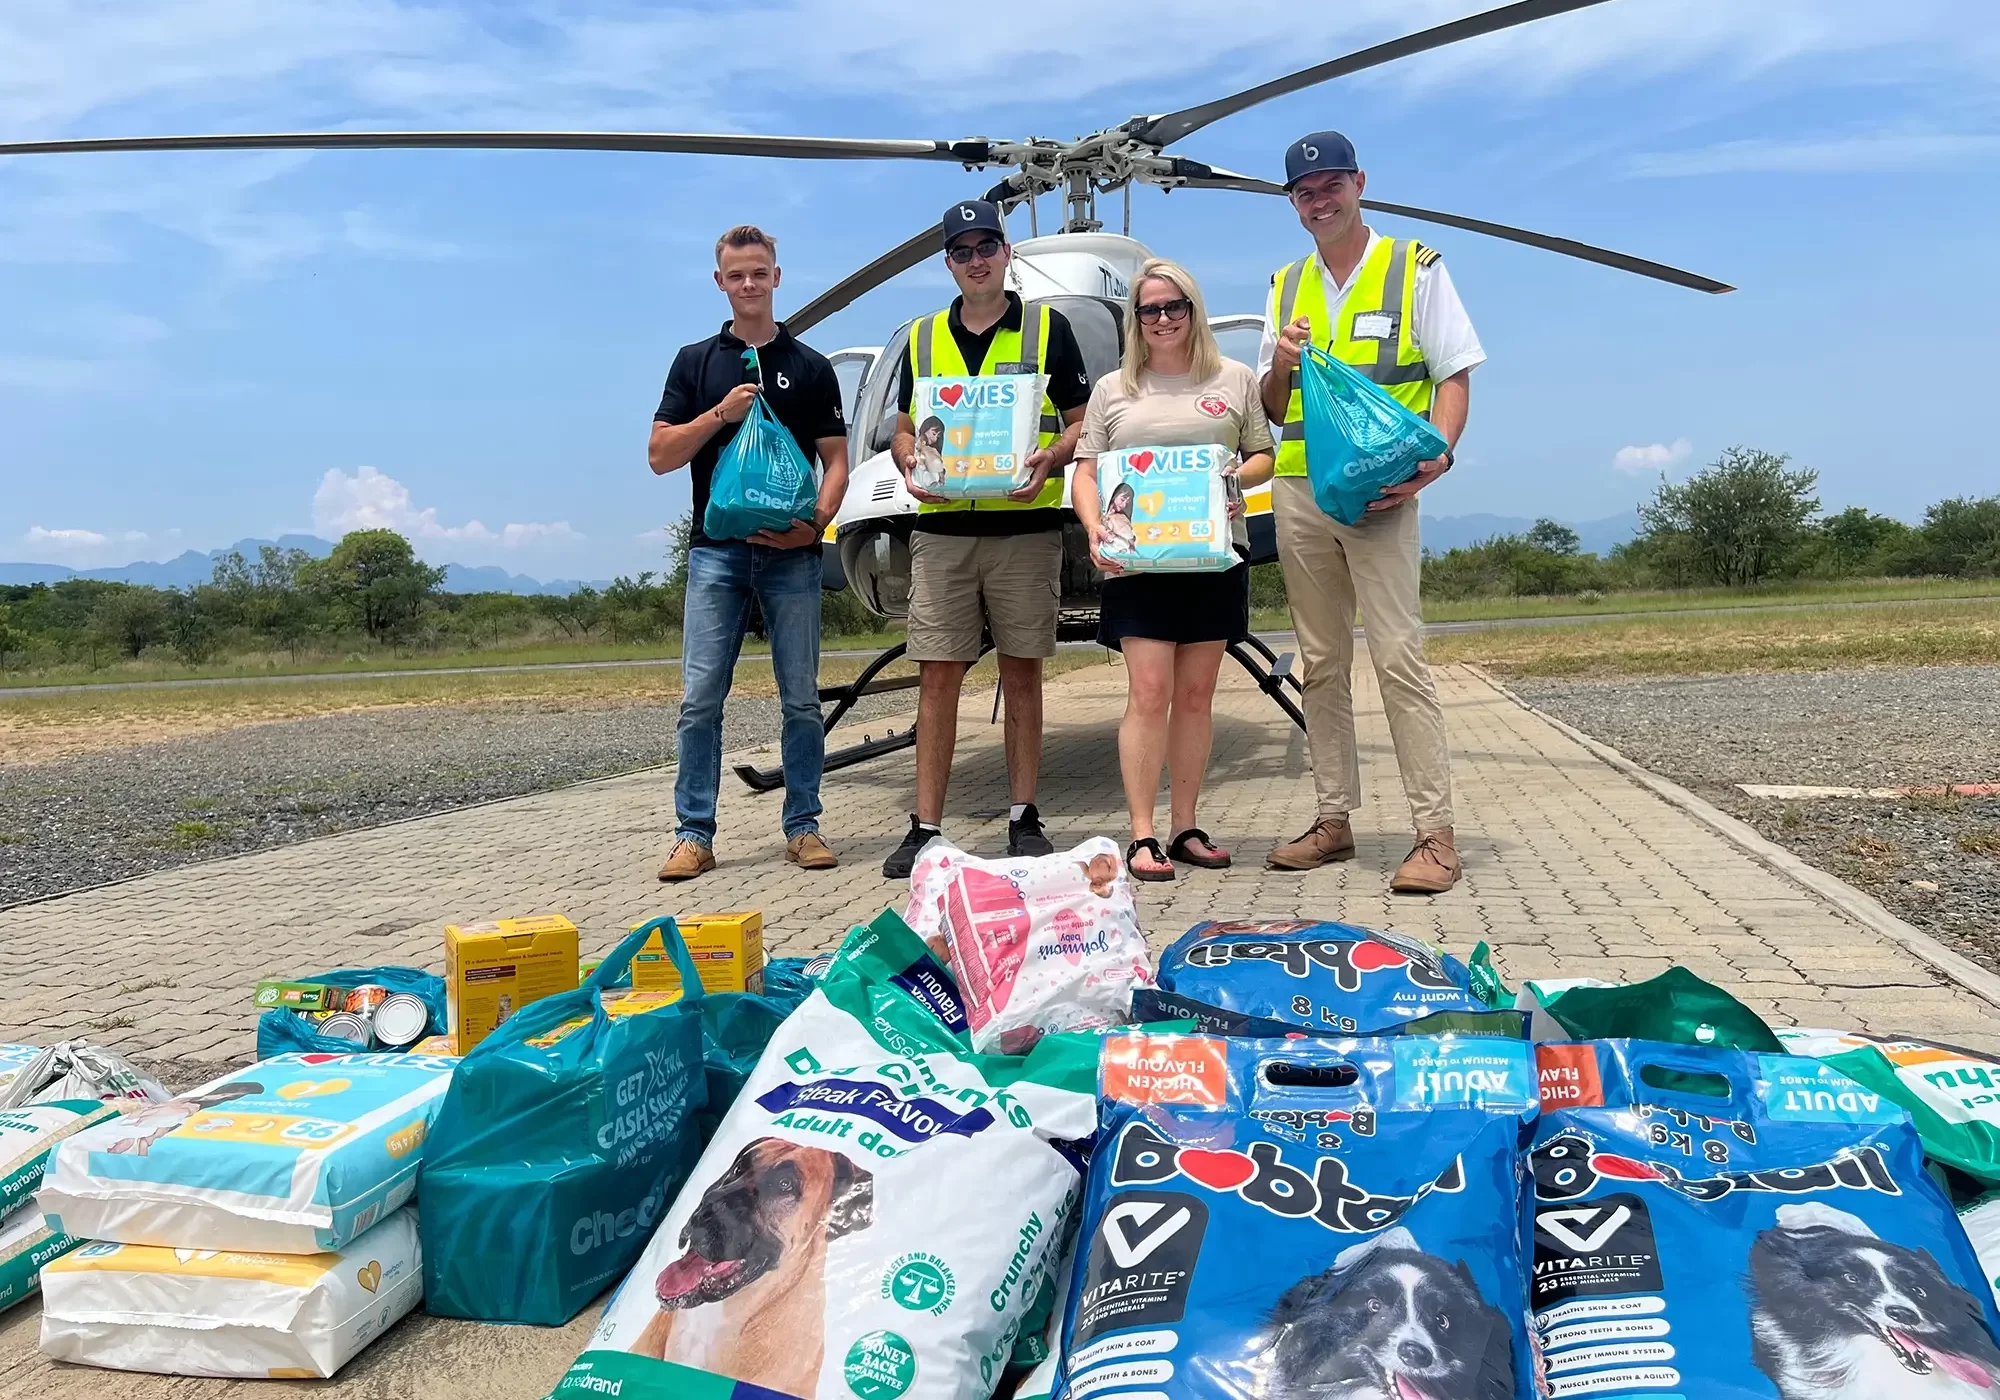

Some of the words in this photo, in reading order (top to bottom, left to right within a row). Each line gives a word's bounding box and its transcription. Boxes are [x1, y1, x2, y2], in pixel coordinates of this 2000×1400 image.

[995, 457, 1012, 468] 56
[1191, 522, 1209, 535] 56
[1071, 919, 1094, 929] gentle
[1060, 933, 1081, 942] baby
[917, 971, 963, 1025] Flavour
[1393, 991, 1417, 1003] my
[1420, 993, 1460, 1004] want
[1292, 995, 1313, 1017] 8
[1321, 1006, 1358, 1033] kg
[1126, 1058, 1206, 1073] FLAVOUR
[1412, 1057, 1448, 1067] LARGE
[1462, 1056, 1509, 1066] MEDIUM
[1539, 1067, 1580, 1082] FLAV
[1779, 1075, 1817, 1085] LARGE
[616, 1071, 644, 1107] GET
[1413, 1069, 1510, 1099] ADULT
[1540, 1084, 1581, 1101] CHIC
[1784, 1090, 1880, 1113] ADULT
[290, 1121, 339, 1138] 56
[597, 1103, 648, 1149] CASH
[771, 1112, 854, 1138] Adult
[1702, 1139, 1729, 1164] 8
[2, 1160, 48, 1197] Parboile
[31, 1233, 81, 1265] Parboile
[907, 1251, 927, 1261] AND
[990, 1210, 1044, 1313] Crunchy
[881, 1256, 906, 1300] COMPLETE
[928, 1254, 957, 1296] BALANCED
[1559, 1274, 1599, 1282] ESSENTIAL
[1580, 1277, 1619, 1285] MINERALS
[1539, 1279, 1558, 1293] 23
[930, 1297, 956, 1317] MEAL
[1094, 1312, 1109, 1322] AND
[1110, 1303, 1146, 1316] MINERALS
[1095, 1300, 1129, 1314] ESSENTIAL
[1131, 1295, 1168, 1305] VITAMINS
[1552, 1306, 1585, 1319] HEALTHY
[1080, 1313, 1095, 1331] 23
[1554, 1329, 1587, 1341] STRONG
[1590, 1326, 1613, 1334] TEETH
[1625, 1324, 1654, 1332] BONES
[861, 1337, 912, 1366] MONEY
[1078, 1347, 1104, 1363] HEALTHY
[1105, 1342, 1124, 1352] SKIN
[1135, 1339, 1156, 1347] COAT
[1557, 1353, 1591, 1365] HEALTHY
[1594, 1349, 1629, 1358] IMMUNE
[1632, 1347, 1665, 1355] SYSTEM
[860, 1351, 900, 1378] BACK
[850, 1363, 904, 1391] GUARANTEE
[1073, 1377, 1097, 1393] STRONG
[1099, 1372, 1120, 1381] TEETH
[1131, 1368, 1158, 1377] BONES
[1559, 1379, 1590, 1390] MUSCLE
[1592, 1374, 1633, 1384] STRENGTH
[1643, 1372, 1676, 1380] AGILITY
